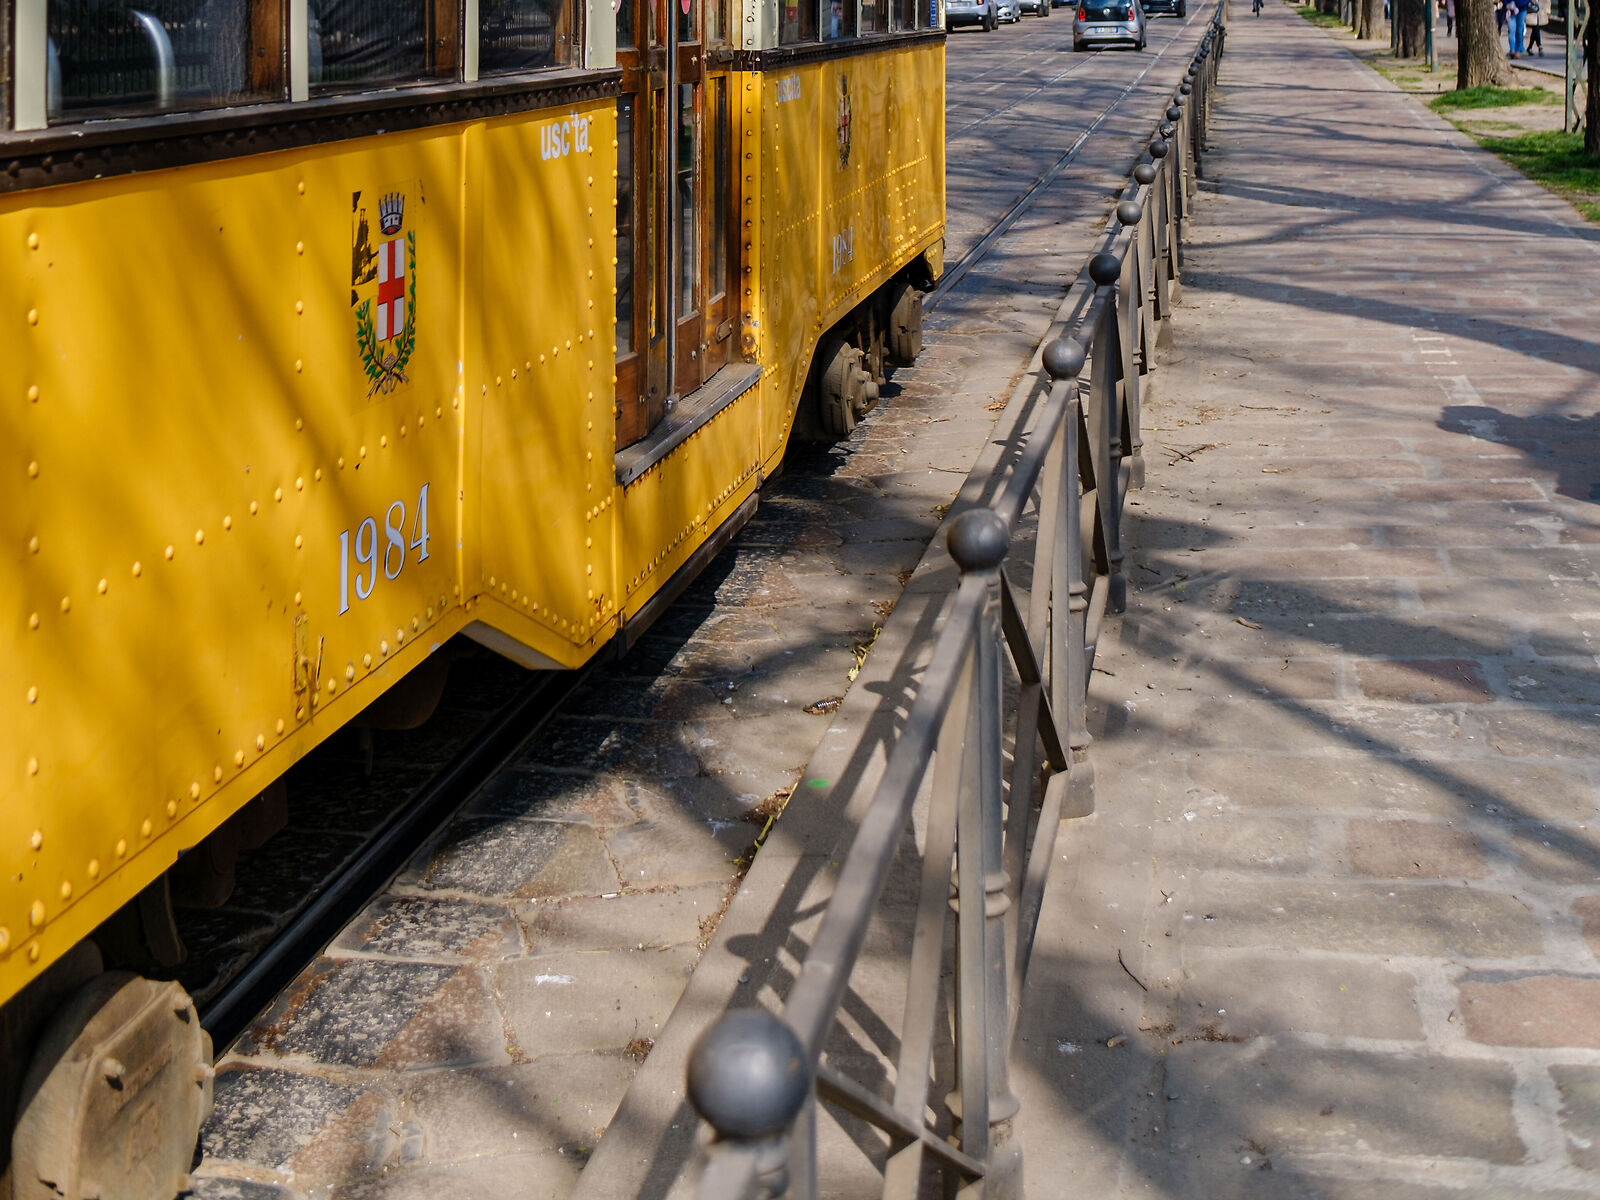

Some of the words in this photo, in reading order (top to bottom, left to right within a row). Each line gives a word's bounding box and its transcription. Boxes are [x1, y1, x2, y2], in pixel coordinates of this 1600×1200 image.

[778, 71, 801, 103] uscita
[832, 225, 853, 274] 1984
[338, 482, 430, 616] 1984
